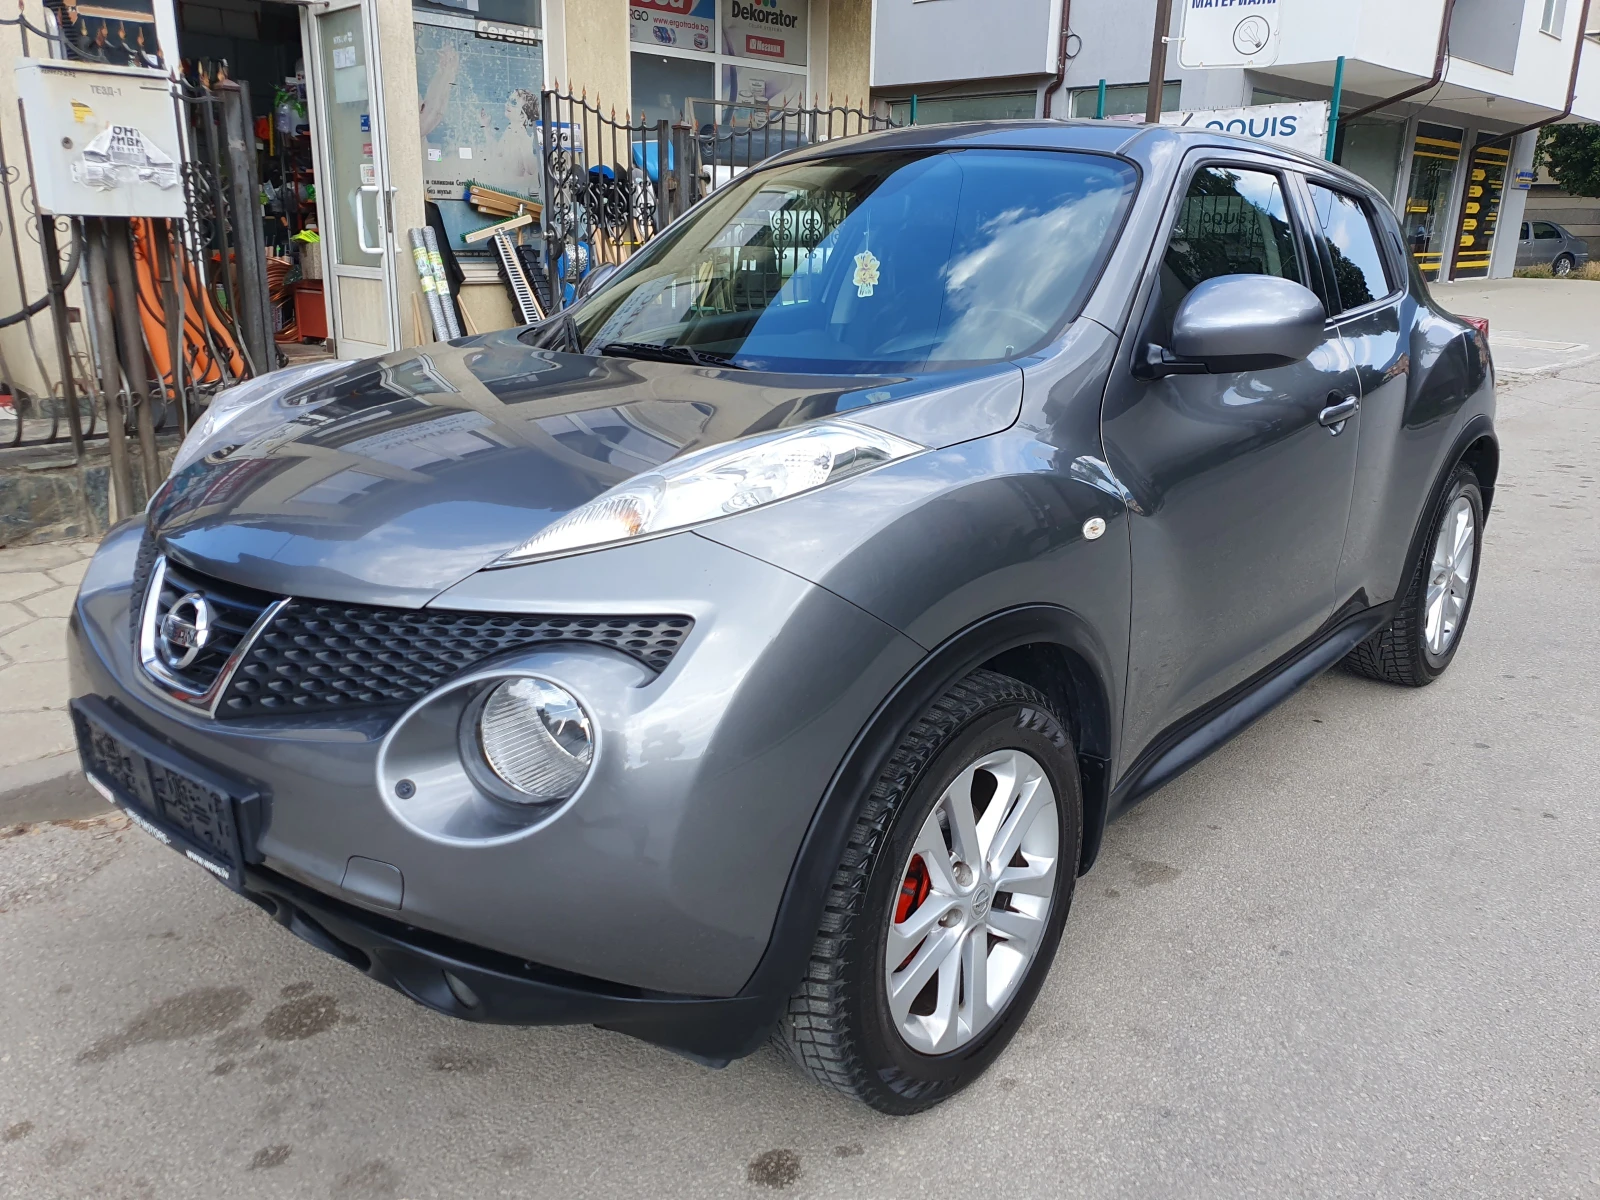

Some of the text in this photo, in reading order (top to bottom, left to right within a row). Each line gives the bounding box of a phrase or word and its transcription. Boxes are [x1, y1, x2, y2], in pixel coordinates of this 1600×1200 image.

[732, 0, 798, 28] Dekorator
[477, 20, 536, 45] Ceresit
[652, 17, 710, 33] www.ergotrade.bg
[90, 84, 122, 97] ТЕЗД-1
